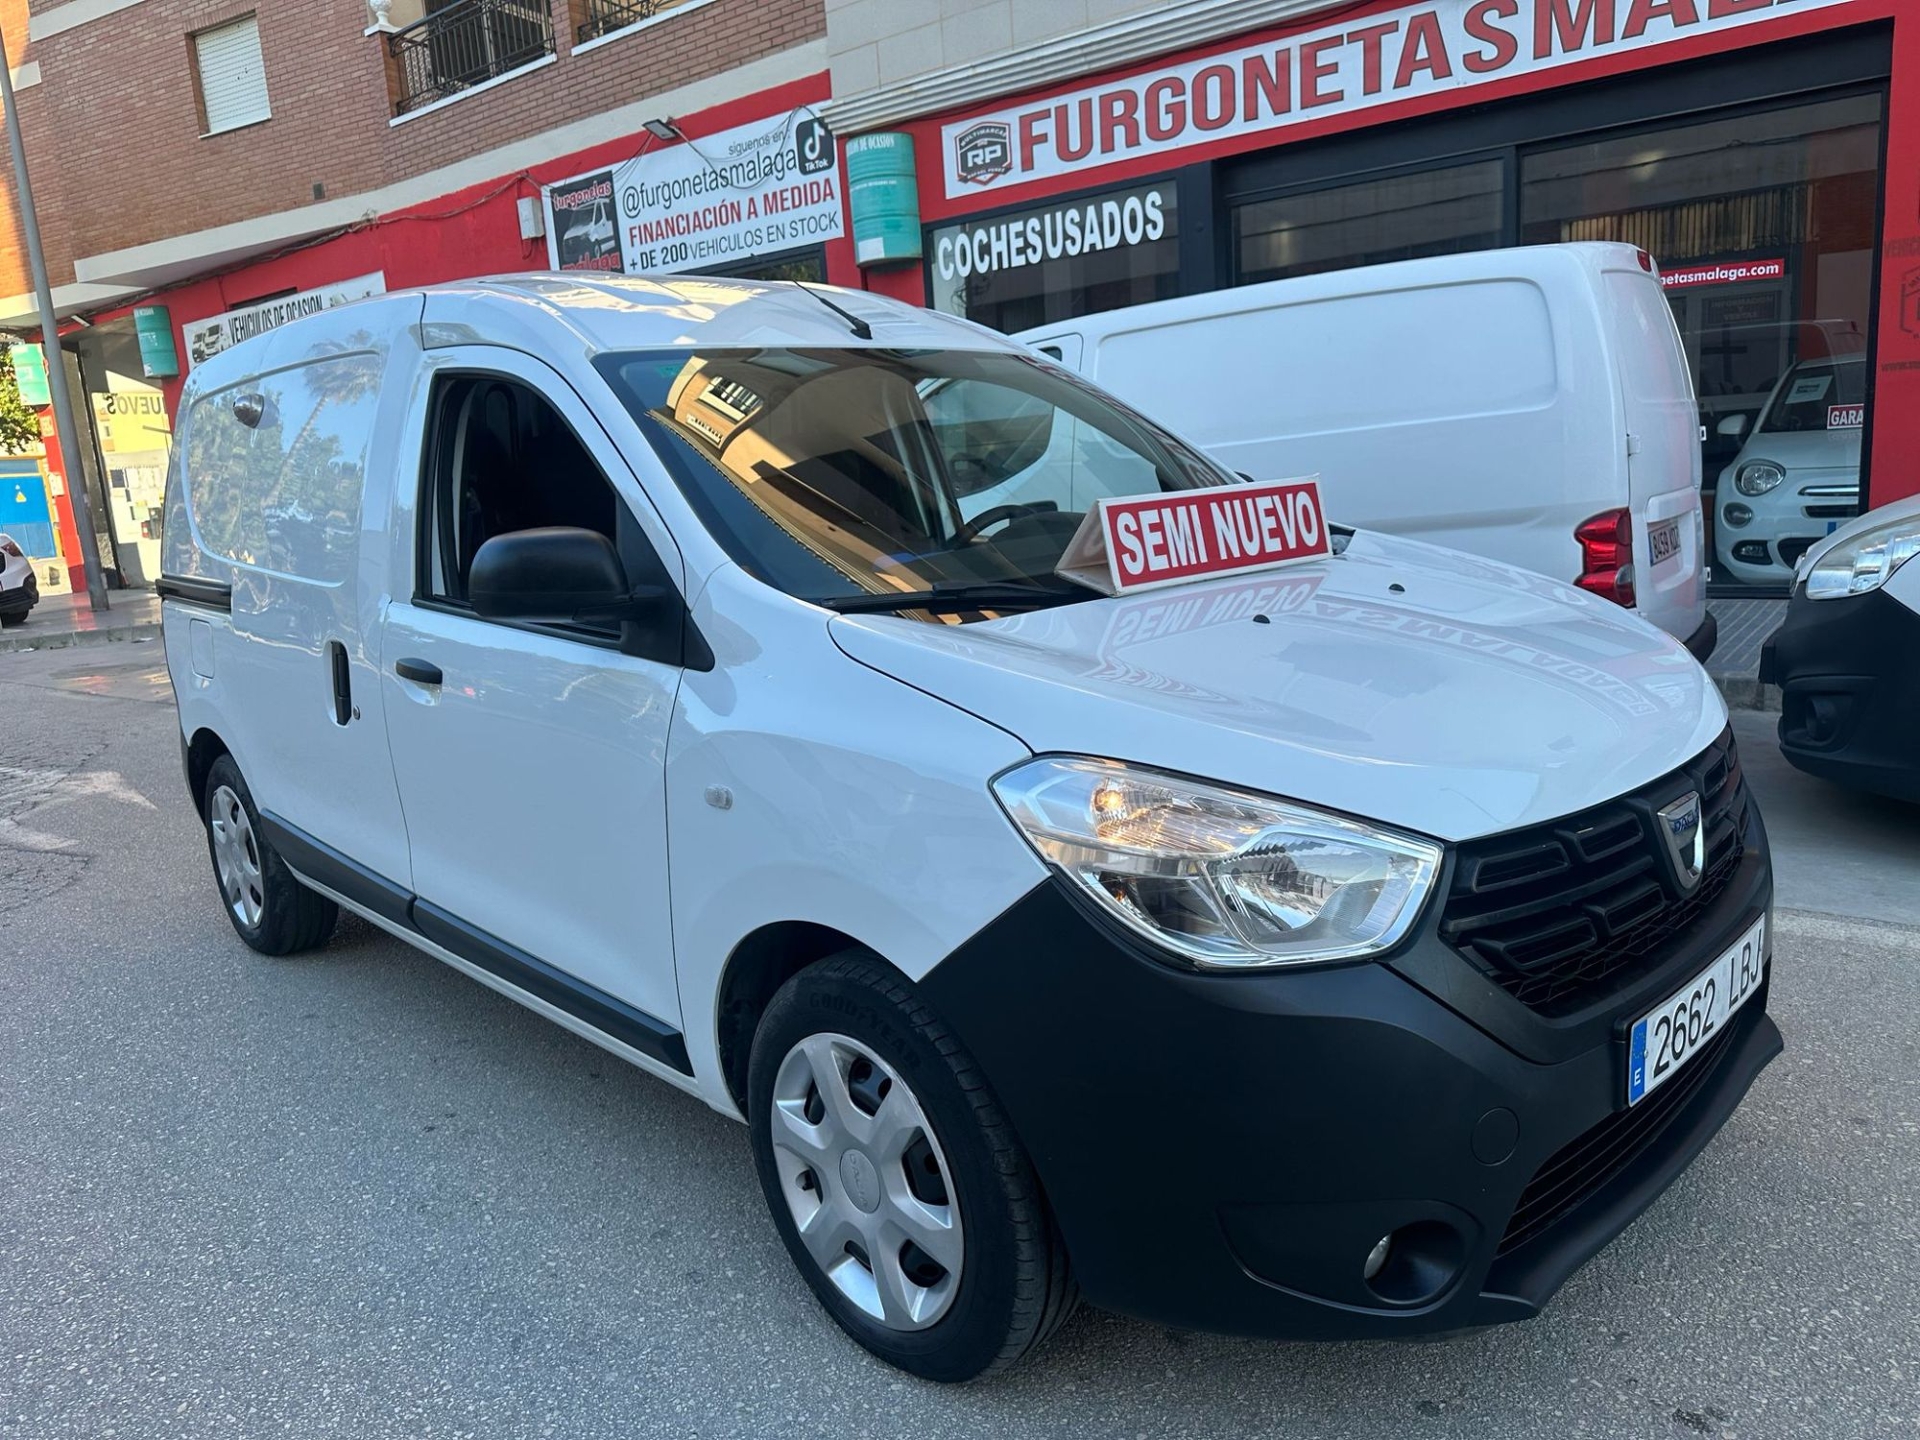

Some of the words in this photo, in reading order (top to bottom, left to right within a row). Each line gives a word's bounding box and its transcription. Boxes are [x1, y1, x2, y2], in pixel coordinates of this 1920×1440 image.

[1019, 0, 1799, 172] FURGONETASMA
[622, 148, 797, 219] @furgonetasmalaga
[804, 158, 829, 172] TikTok
[966, 144, 1002, 168] RP
[629, 199, 742, 248] FINANCIACIÓN
[747, 197, 758, 220] A
[763, 177, 835, 217] MEDIDA
[639, 249, 657, 270] DE
[661, 242, 688, 266] 200
[686, 229, 763, 260] VEHICULOS
[767, 223, 785, 244] EN
[789, 210, 839, 239] STOCK
[1116, 501, 1209, 576] SEMI
[1212, 490, 1320, 560] NUEVO
[1652, 977, 1716, 1079] 2662
[1728, 927, 1764, 1012] LBJ
[1633, 1066, 1642, 1087] E
